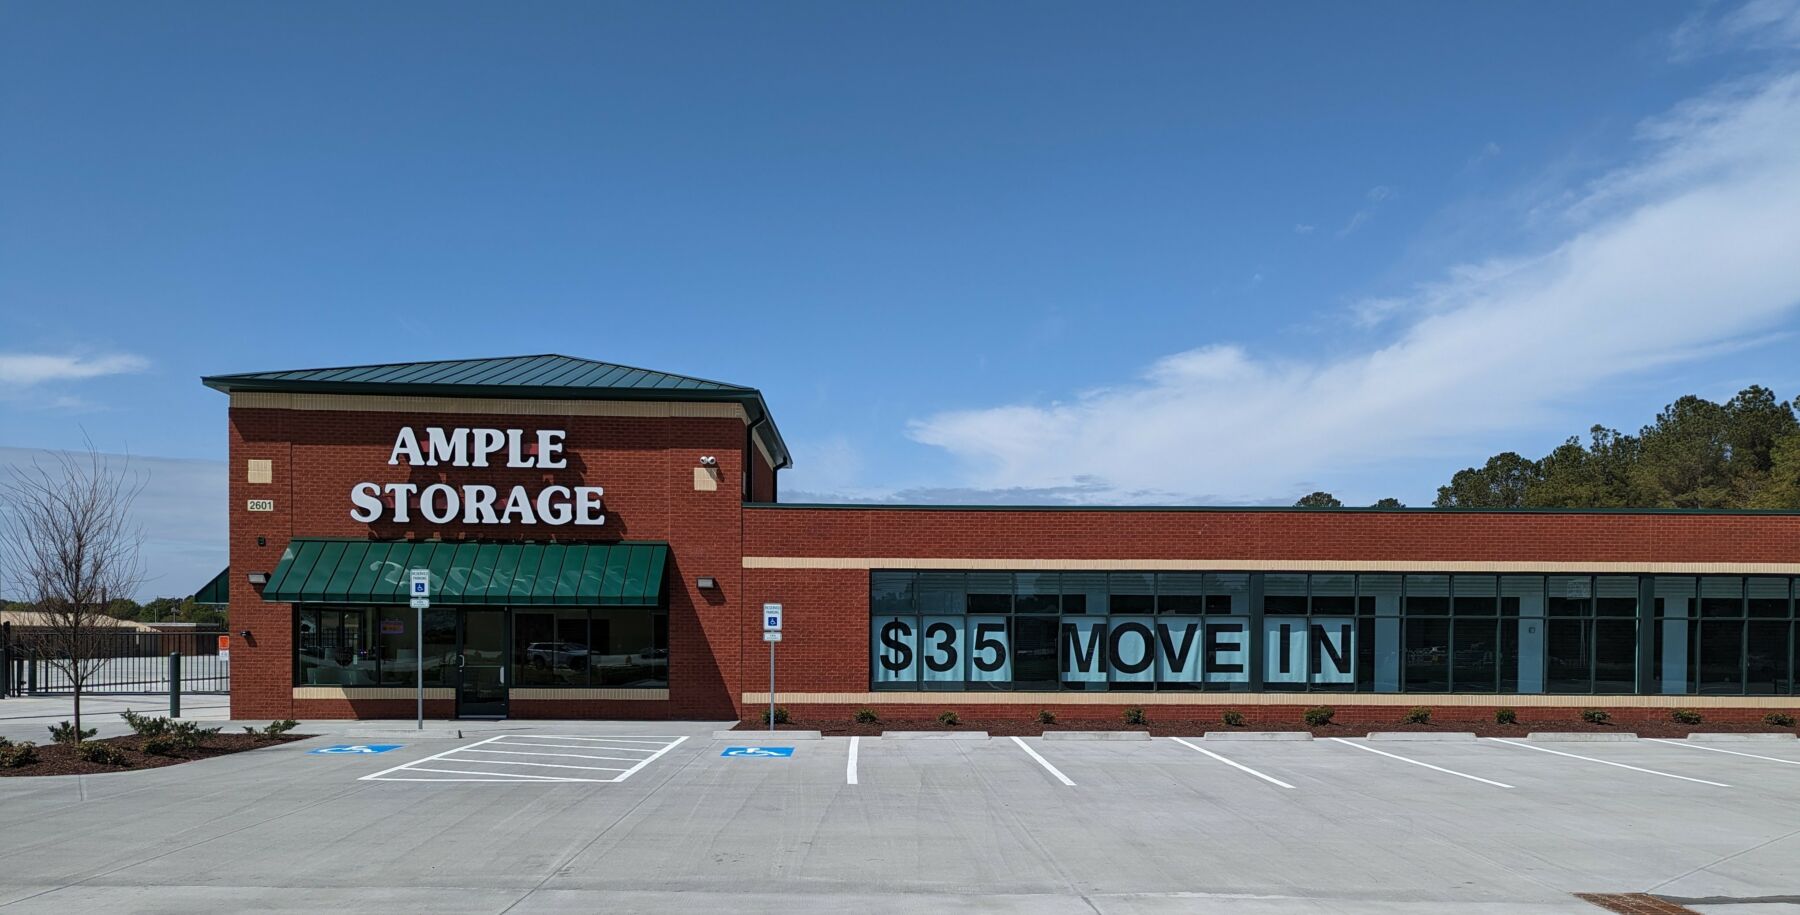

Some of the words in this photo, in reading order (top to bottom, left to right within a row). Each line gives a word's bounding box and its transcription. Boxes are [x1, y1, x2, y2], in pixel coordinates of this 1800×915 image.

[388, 426, 567, 469] AMPLE
[249, 501, 272, 510] 2601
[350, 482, 605, 525] STORAGE
[880, 617, 1007, 677] $35
[1062, 622, 1244, 674] MOVE
[1279, 624, 1352, 674] IN
